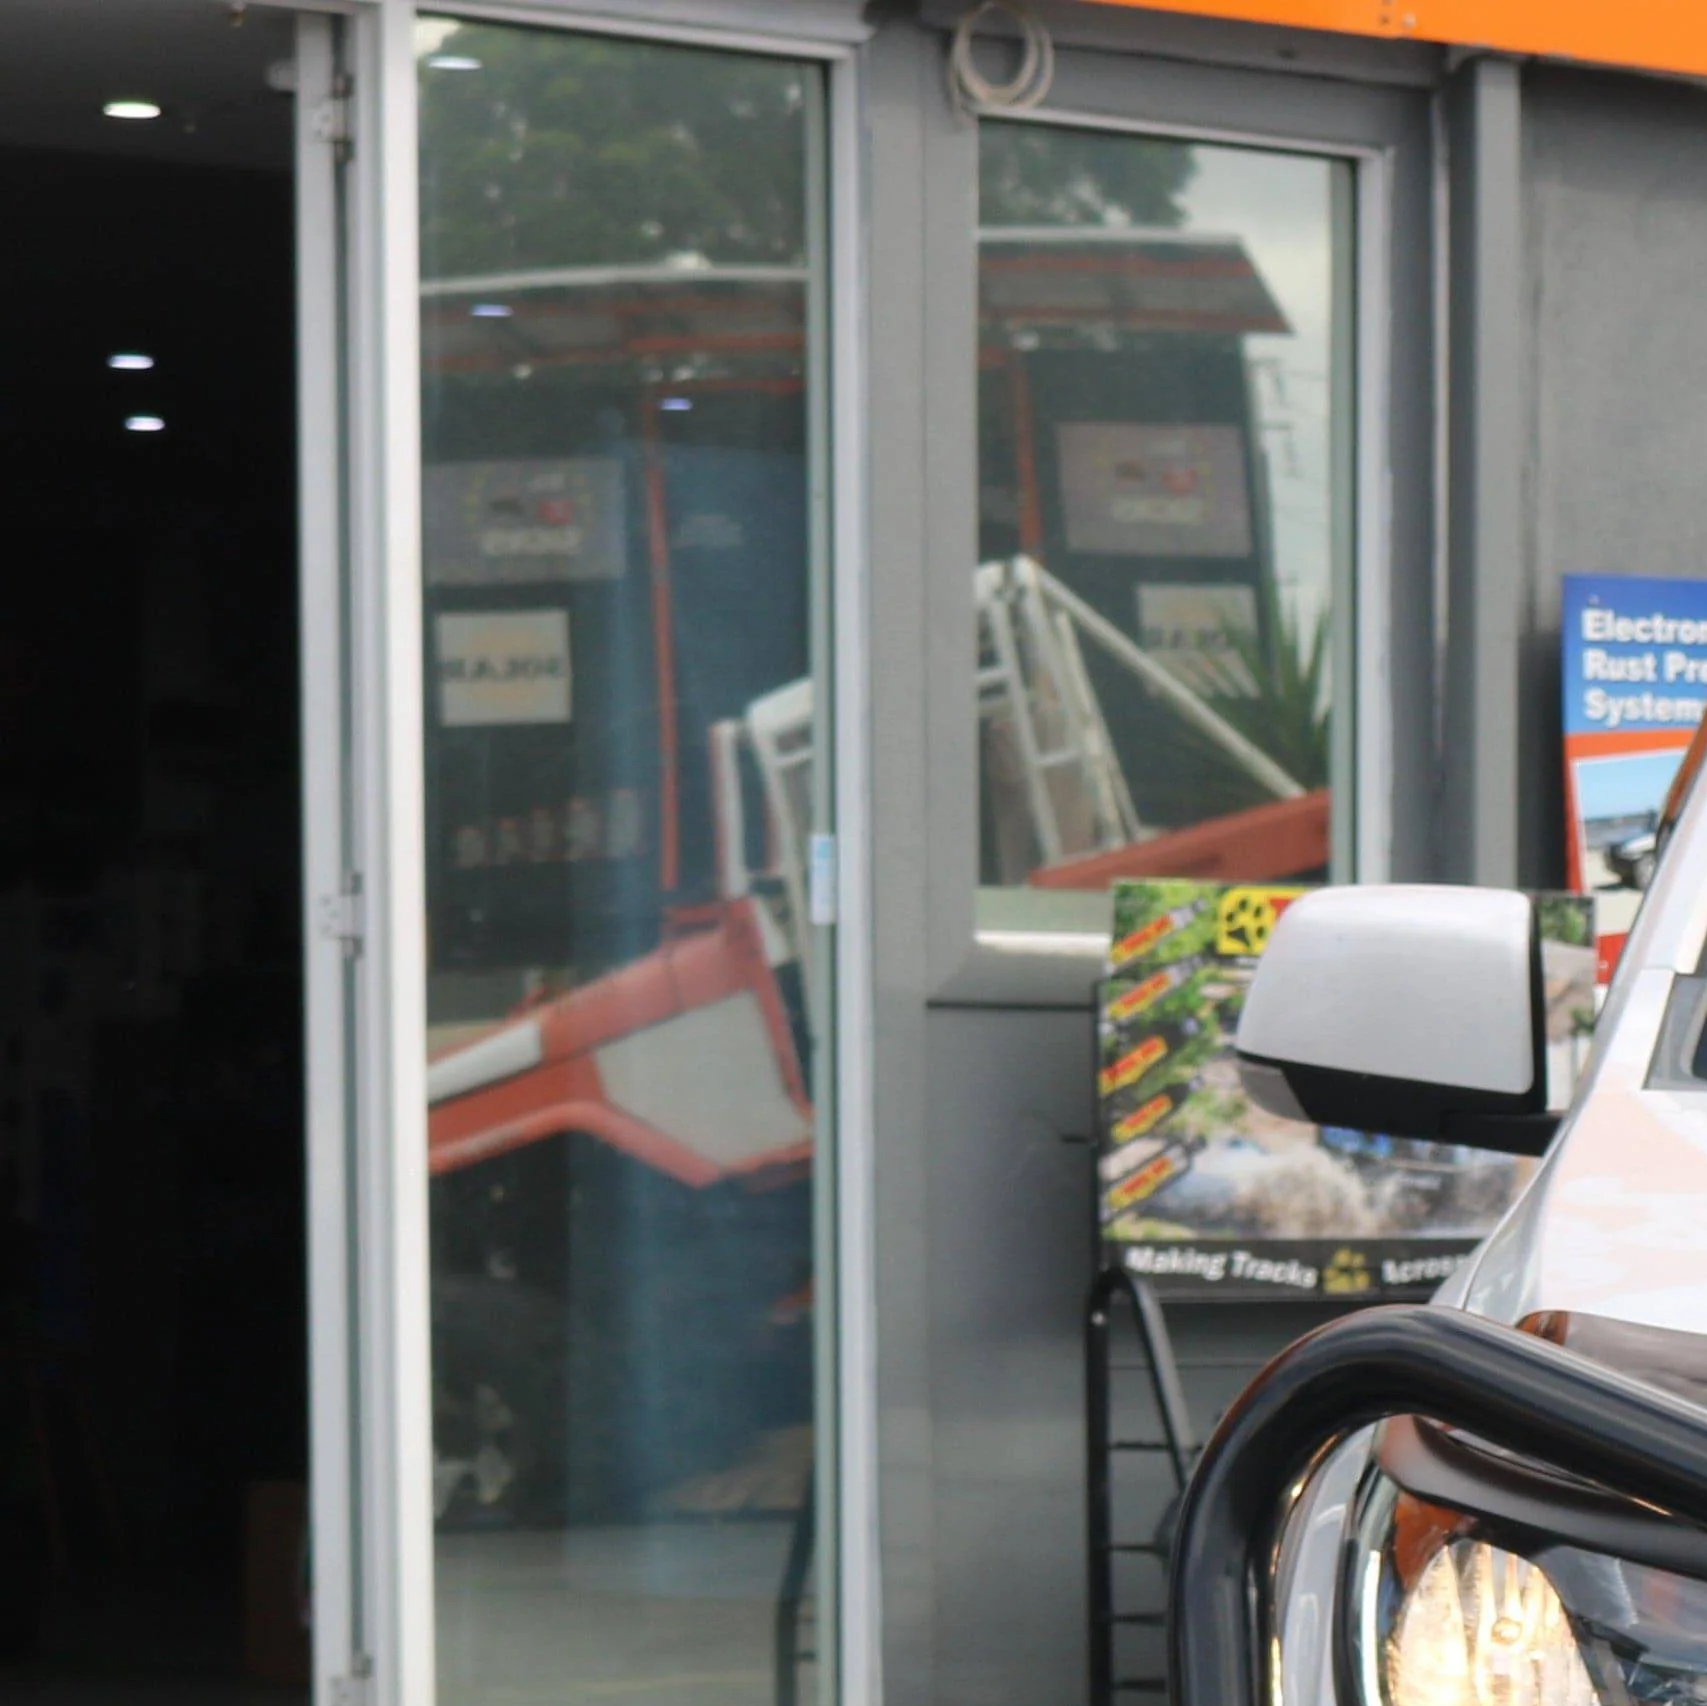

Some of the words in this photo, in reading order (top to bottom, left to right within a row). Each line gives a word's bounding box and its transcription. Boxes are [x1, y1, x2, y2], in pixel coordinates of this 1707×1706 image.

[1582, 647, 1658, 683] Rust
[1125, 1246, 1229, 1282] Making
[1231, 1251, 1319, 1289] Tracks
